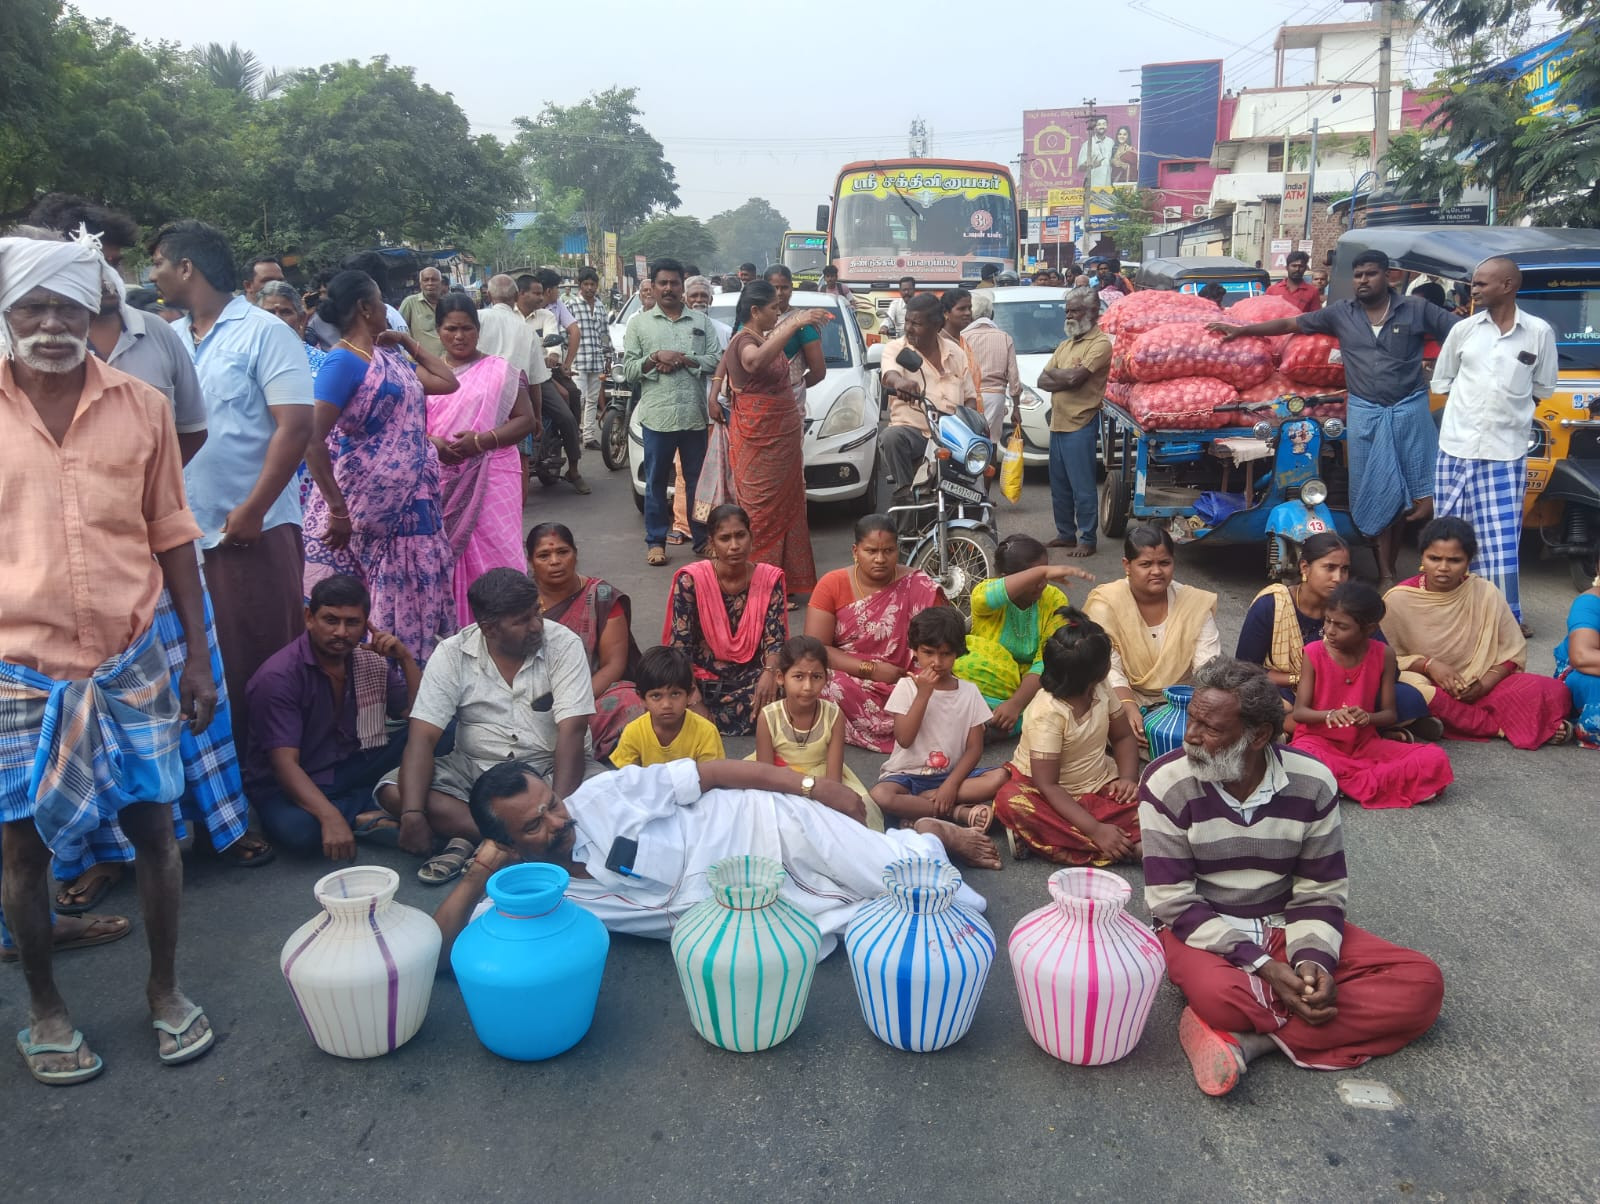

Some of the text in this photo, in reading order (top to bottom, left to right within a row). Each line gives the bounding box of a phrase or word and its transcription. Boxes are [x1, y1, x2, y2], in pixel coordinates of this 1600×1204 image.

[1030, 157, 1073, 180] OVJ
[1285, 191, 1306, 200] ATM
[1310, 521, 1323, 532] 13
